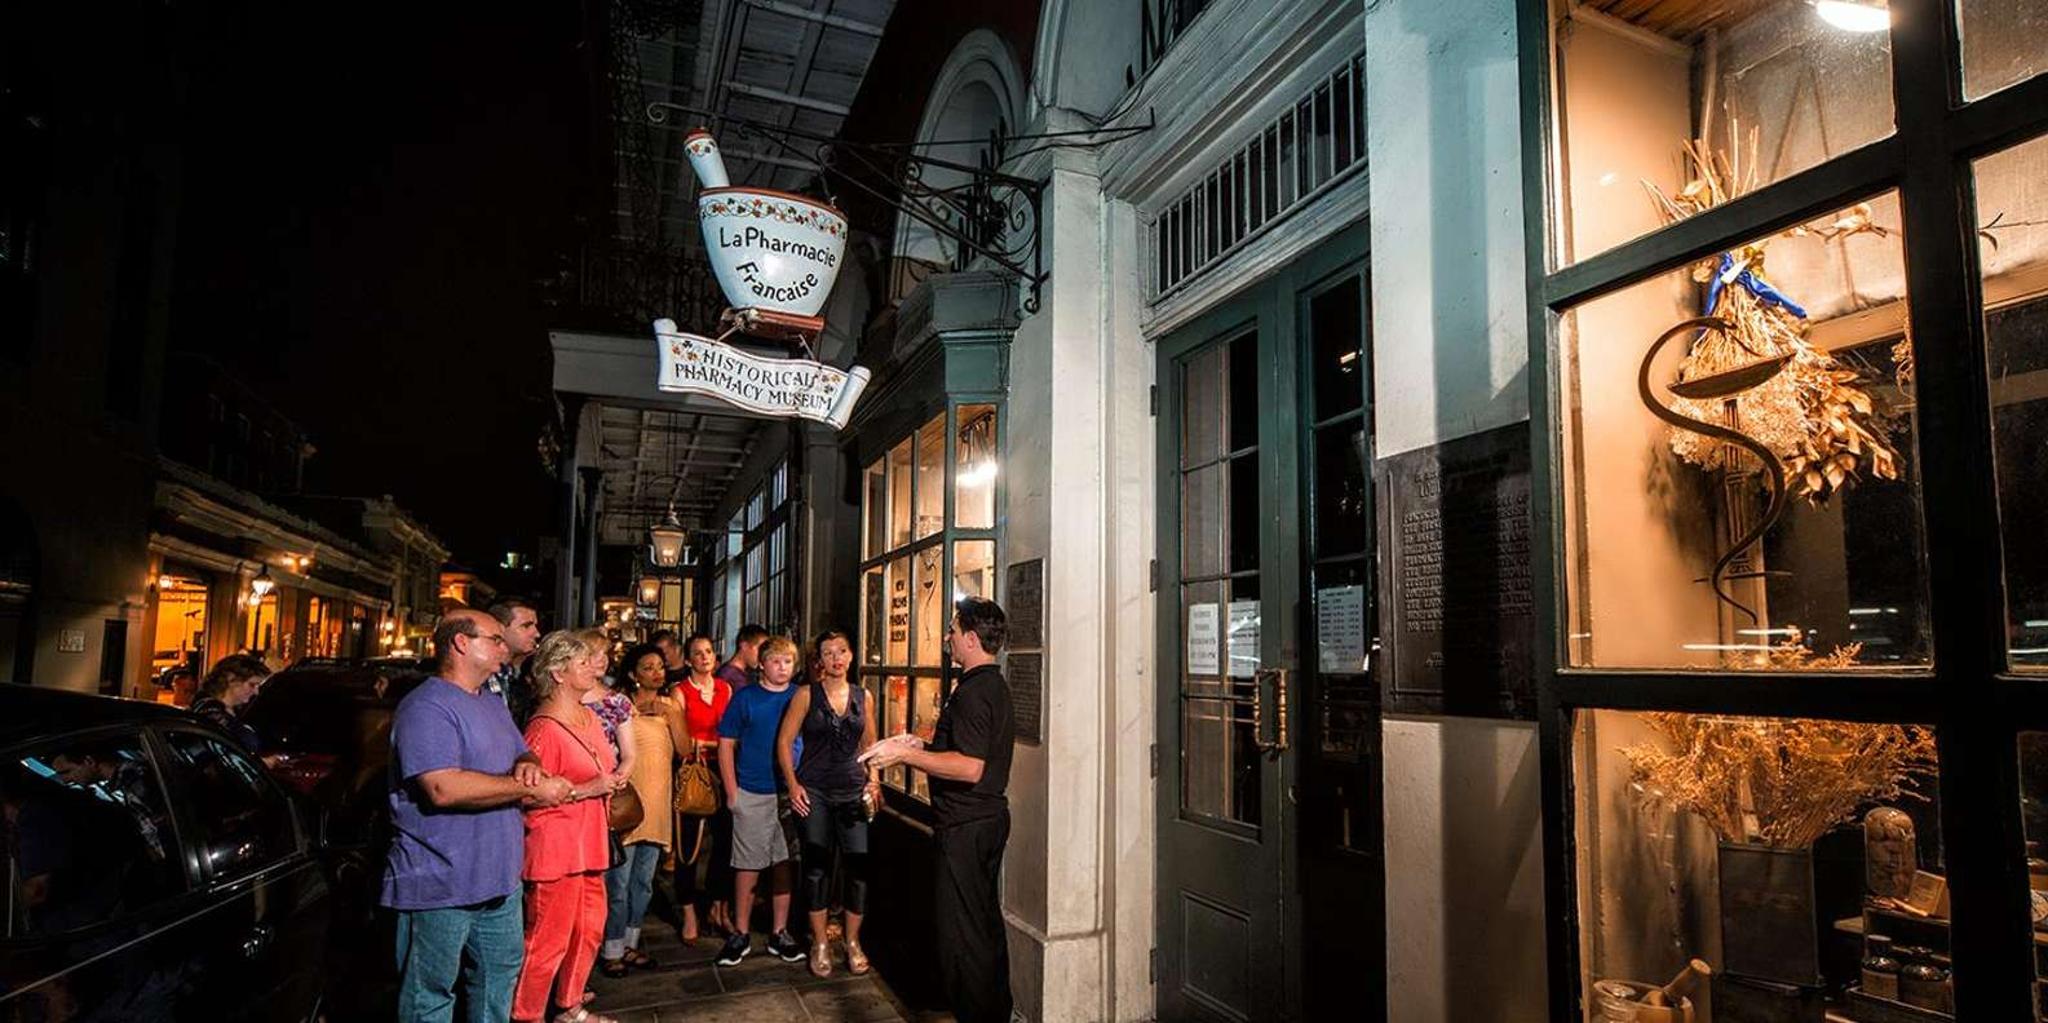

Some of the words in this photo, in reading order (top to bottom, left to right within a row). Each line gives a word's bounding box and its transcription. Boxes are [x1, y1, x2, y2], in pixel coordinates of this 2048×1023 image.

[720, 227, 742, 248] La
[745, 226, 836, 267] Pharmacie
[735, 261, 818, 302] Francaise
[675, 363, 763, 400] PHARMACY
[767, 389, 833, 411] MUSEUM
[703, 350, 819, 391] HISTORICAL
